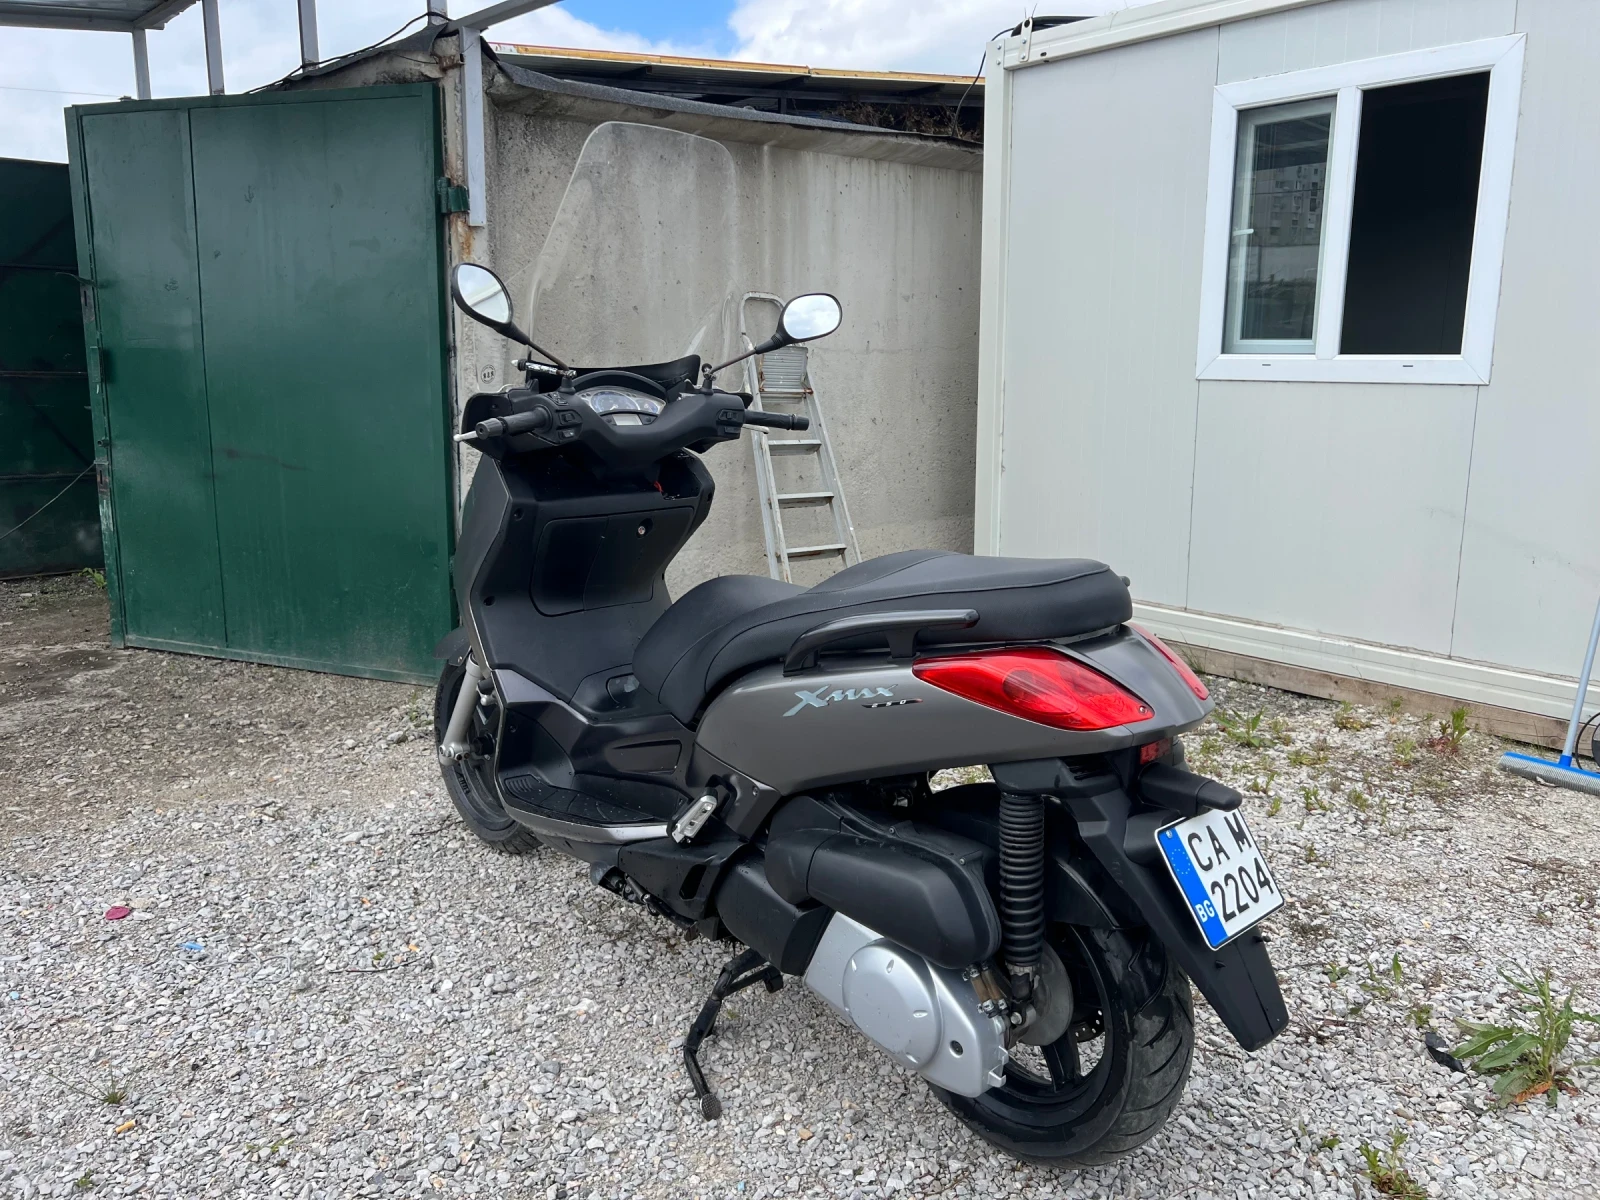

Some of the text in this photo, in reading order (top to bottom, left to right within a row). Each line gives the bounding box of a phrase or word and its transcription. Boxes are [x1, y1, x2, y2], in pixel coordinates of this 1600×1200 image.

[871, 699, 907, 708] 250
[1187, 812, 1252, 872] CA M
[1195, 899, 1216, 923] BG
[1211, 857, 1274, 923] 2204
